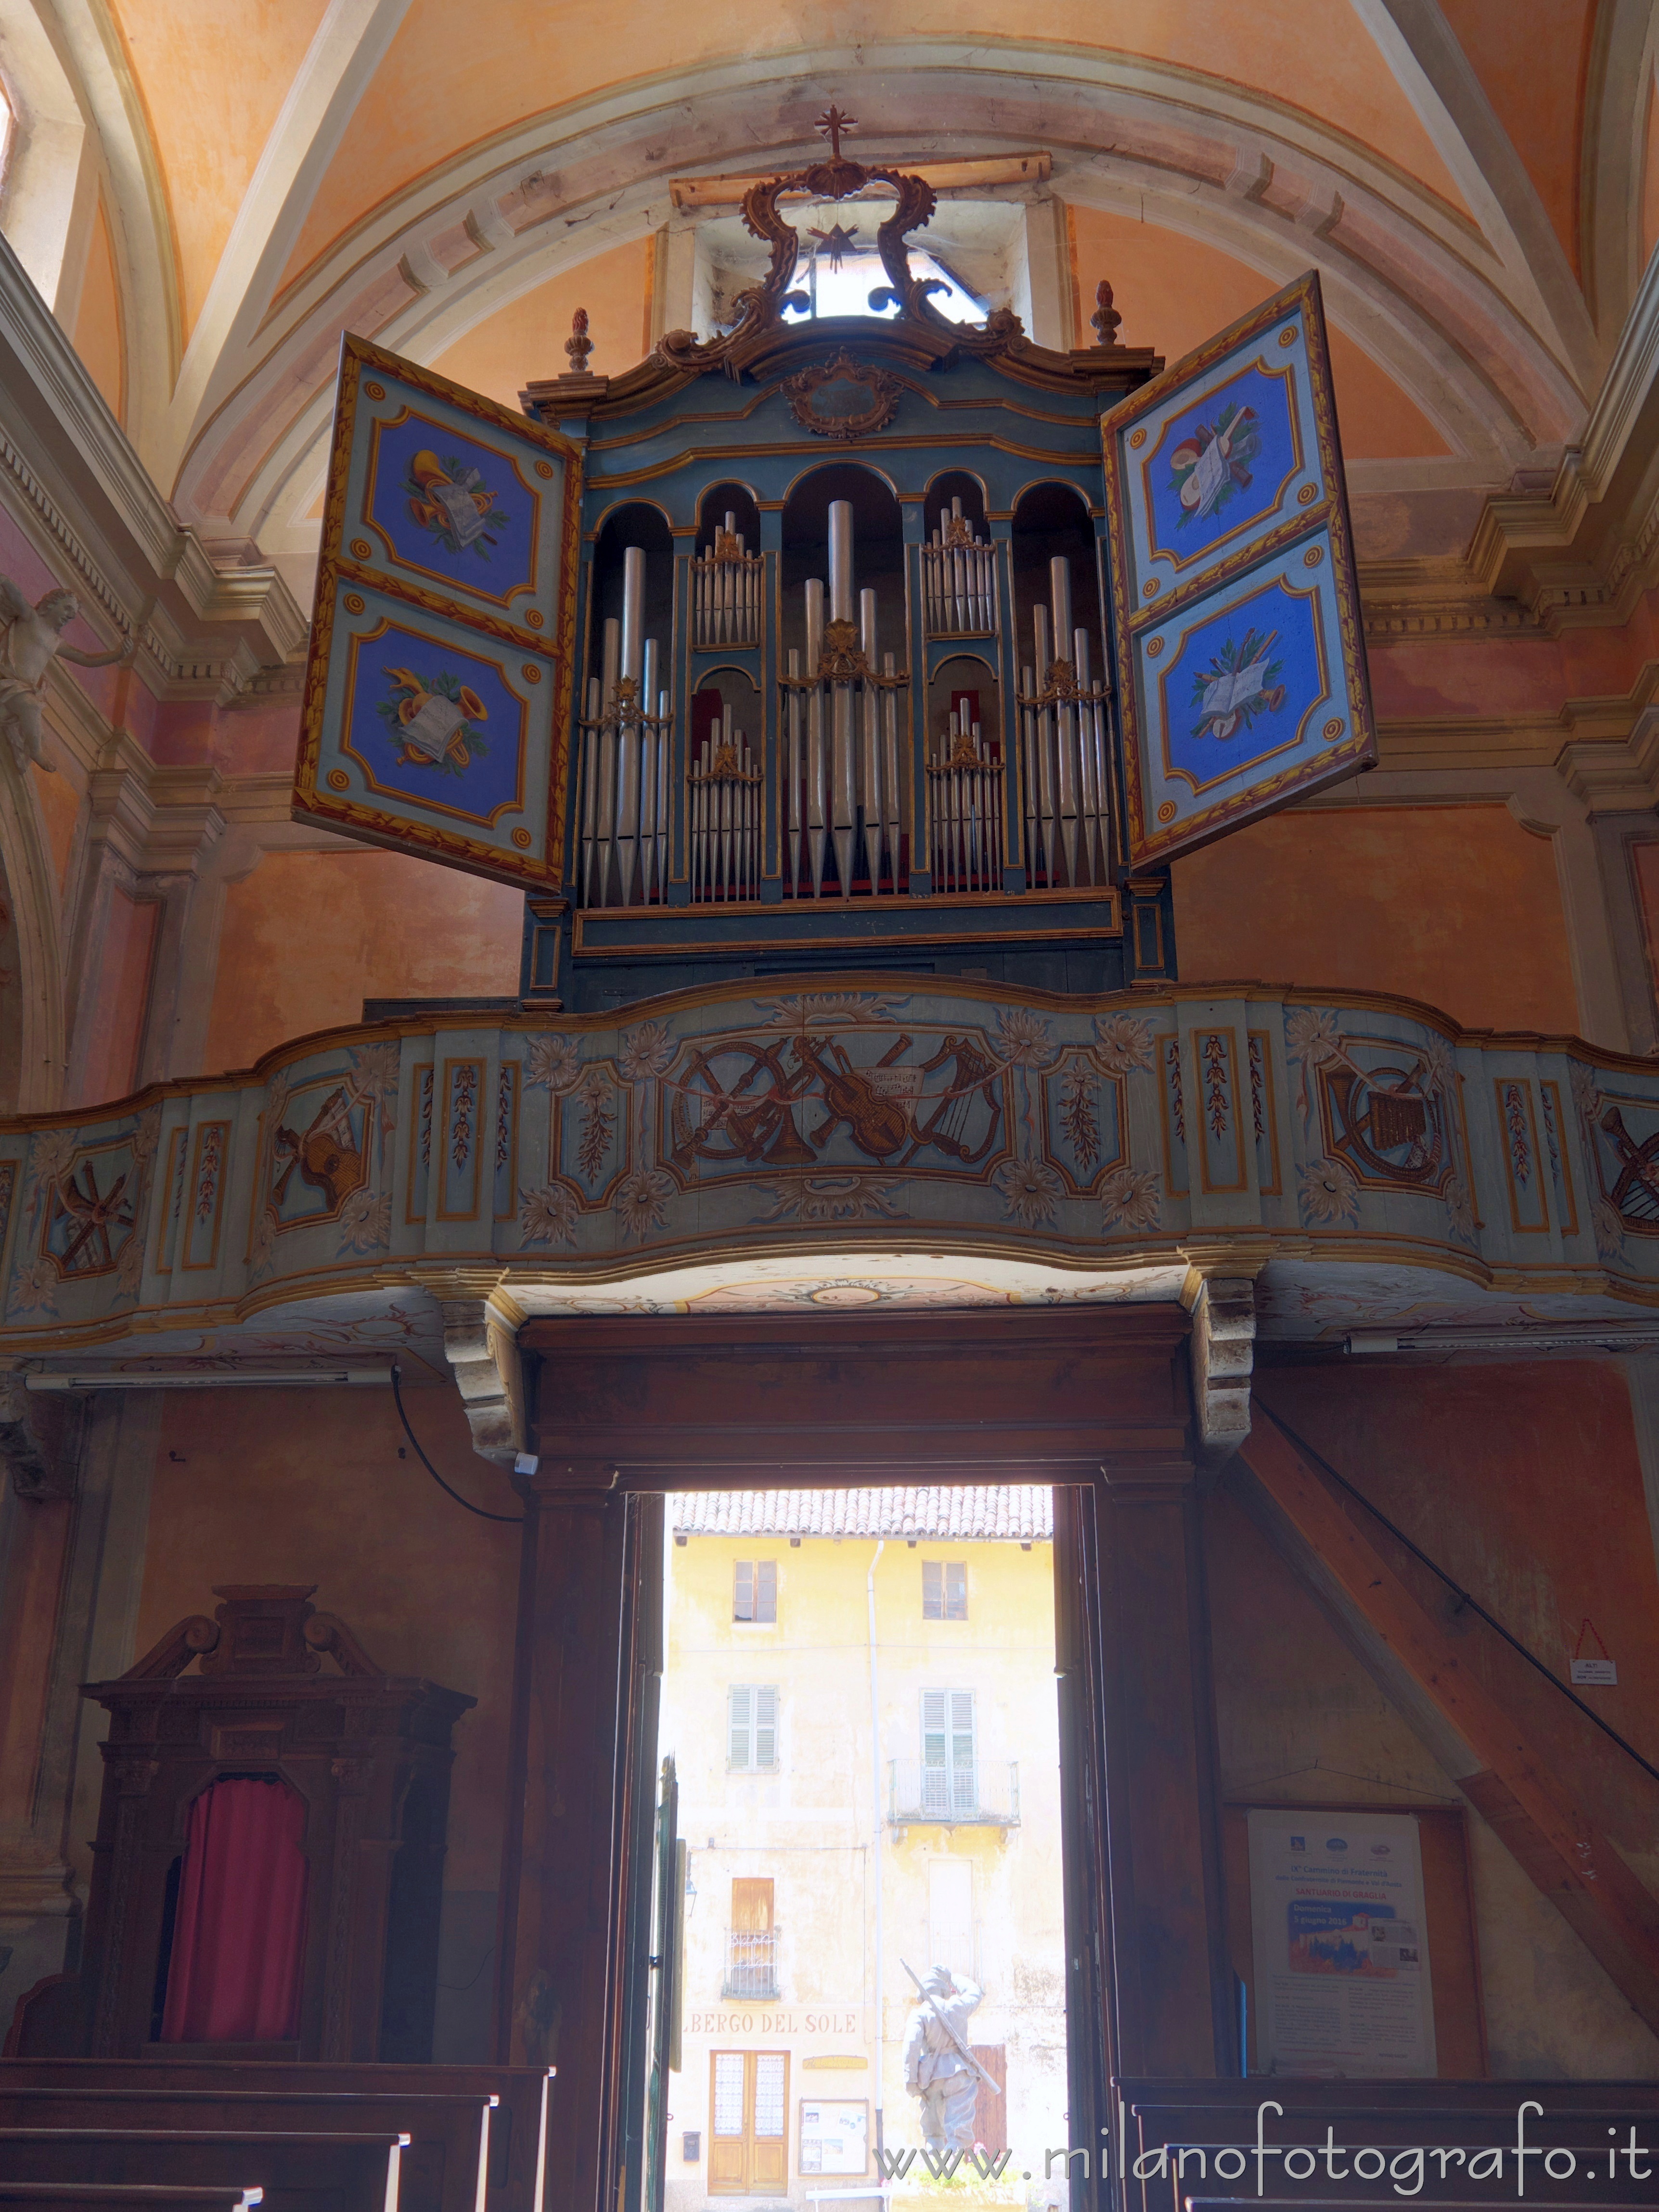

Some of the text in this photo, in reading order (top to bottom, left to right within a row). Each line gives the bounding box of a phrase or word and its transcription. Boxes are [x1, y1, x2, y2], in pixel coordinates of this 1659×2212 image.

[1304, 1867, 1339, 1875] Cammino
[1351, 1869, 1388, 1877] Fraternità
[1296, 1888, 1340, 1897] SANTUARIO
[1353, 1892, 1387, 1900] GRAGLIA
[1294, 1904, 1331, 1913] Domenica
[1301, 1916, 1326, 1926] giugno
[1328, 1917, 1347, 1926] 2016
[761, 2014, 797, 2033] DEL
[805, 2014, 855, 2033] SOLE
